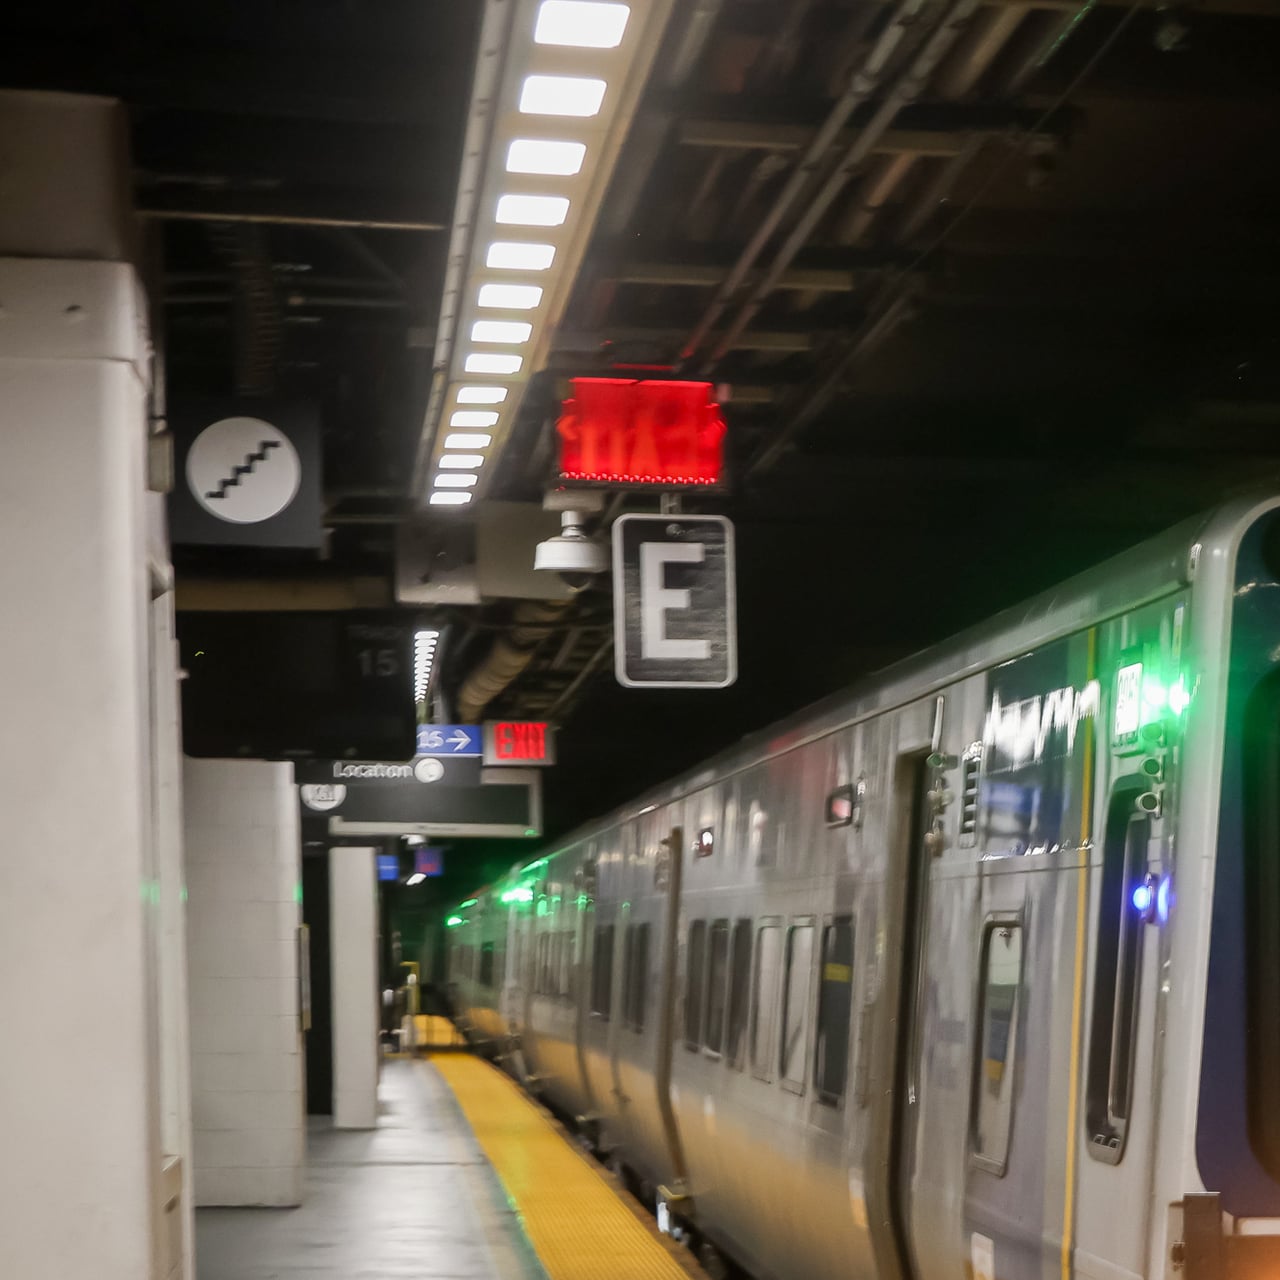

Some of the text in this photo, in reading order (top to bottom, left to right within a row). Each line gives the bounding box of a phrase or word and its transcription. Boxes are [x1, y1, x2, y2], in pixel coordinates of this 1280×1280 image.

[639, 541, 712, 660] E
[494, 722, 549, 760] EXIT
[333, 761, 414, 778] Location
